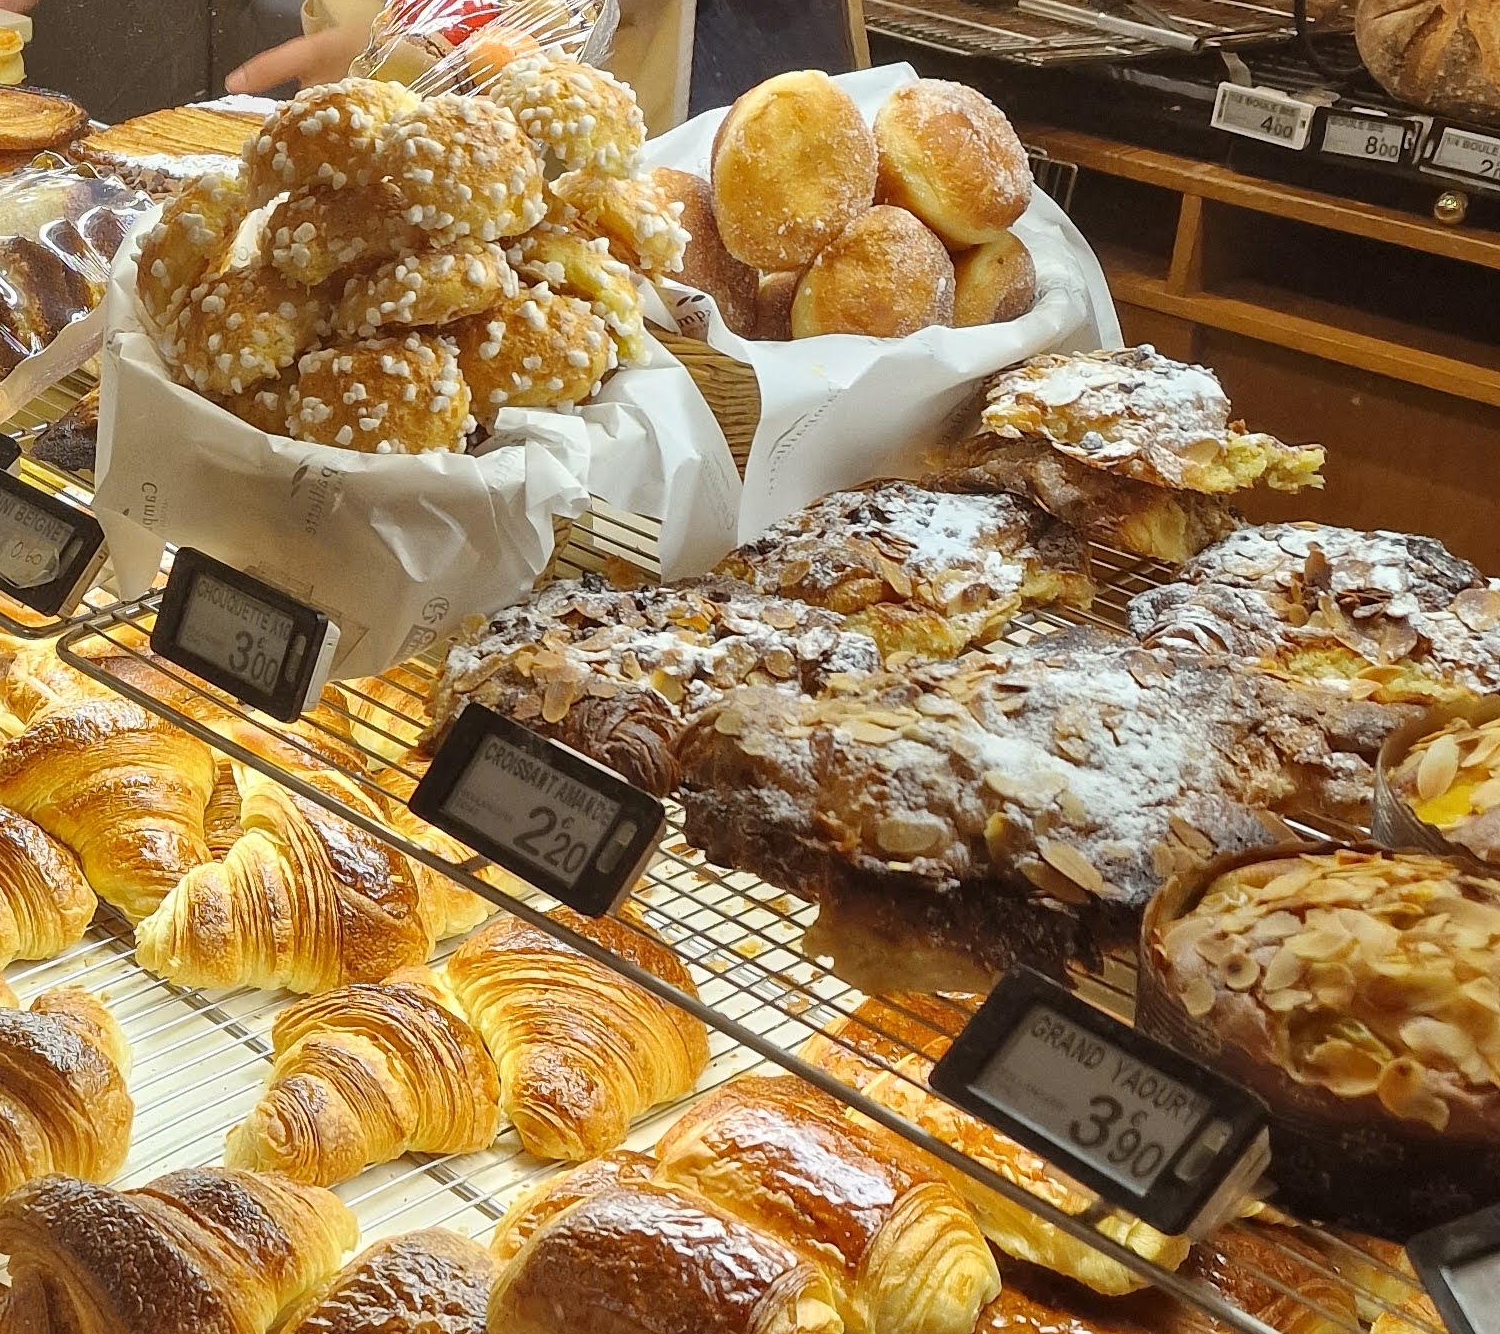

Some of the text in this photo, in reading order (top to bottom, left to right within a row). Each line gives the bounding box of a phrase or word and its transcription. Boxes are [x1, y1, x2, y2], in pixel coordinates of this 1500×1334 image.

[1462, 138, 1499, 156] BOULE
[197, 579, 271, 631] CHOUQUETTE
[1030, 1016, 1106, 1070] GRAND
